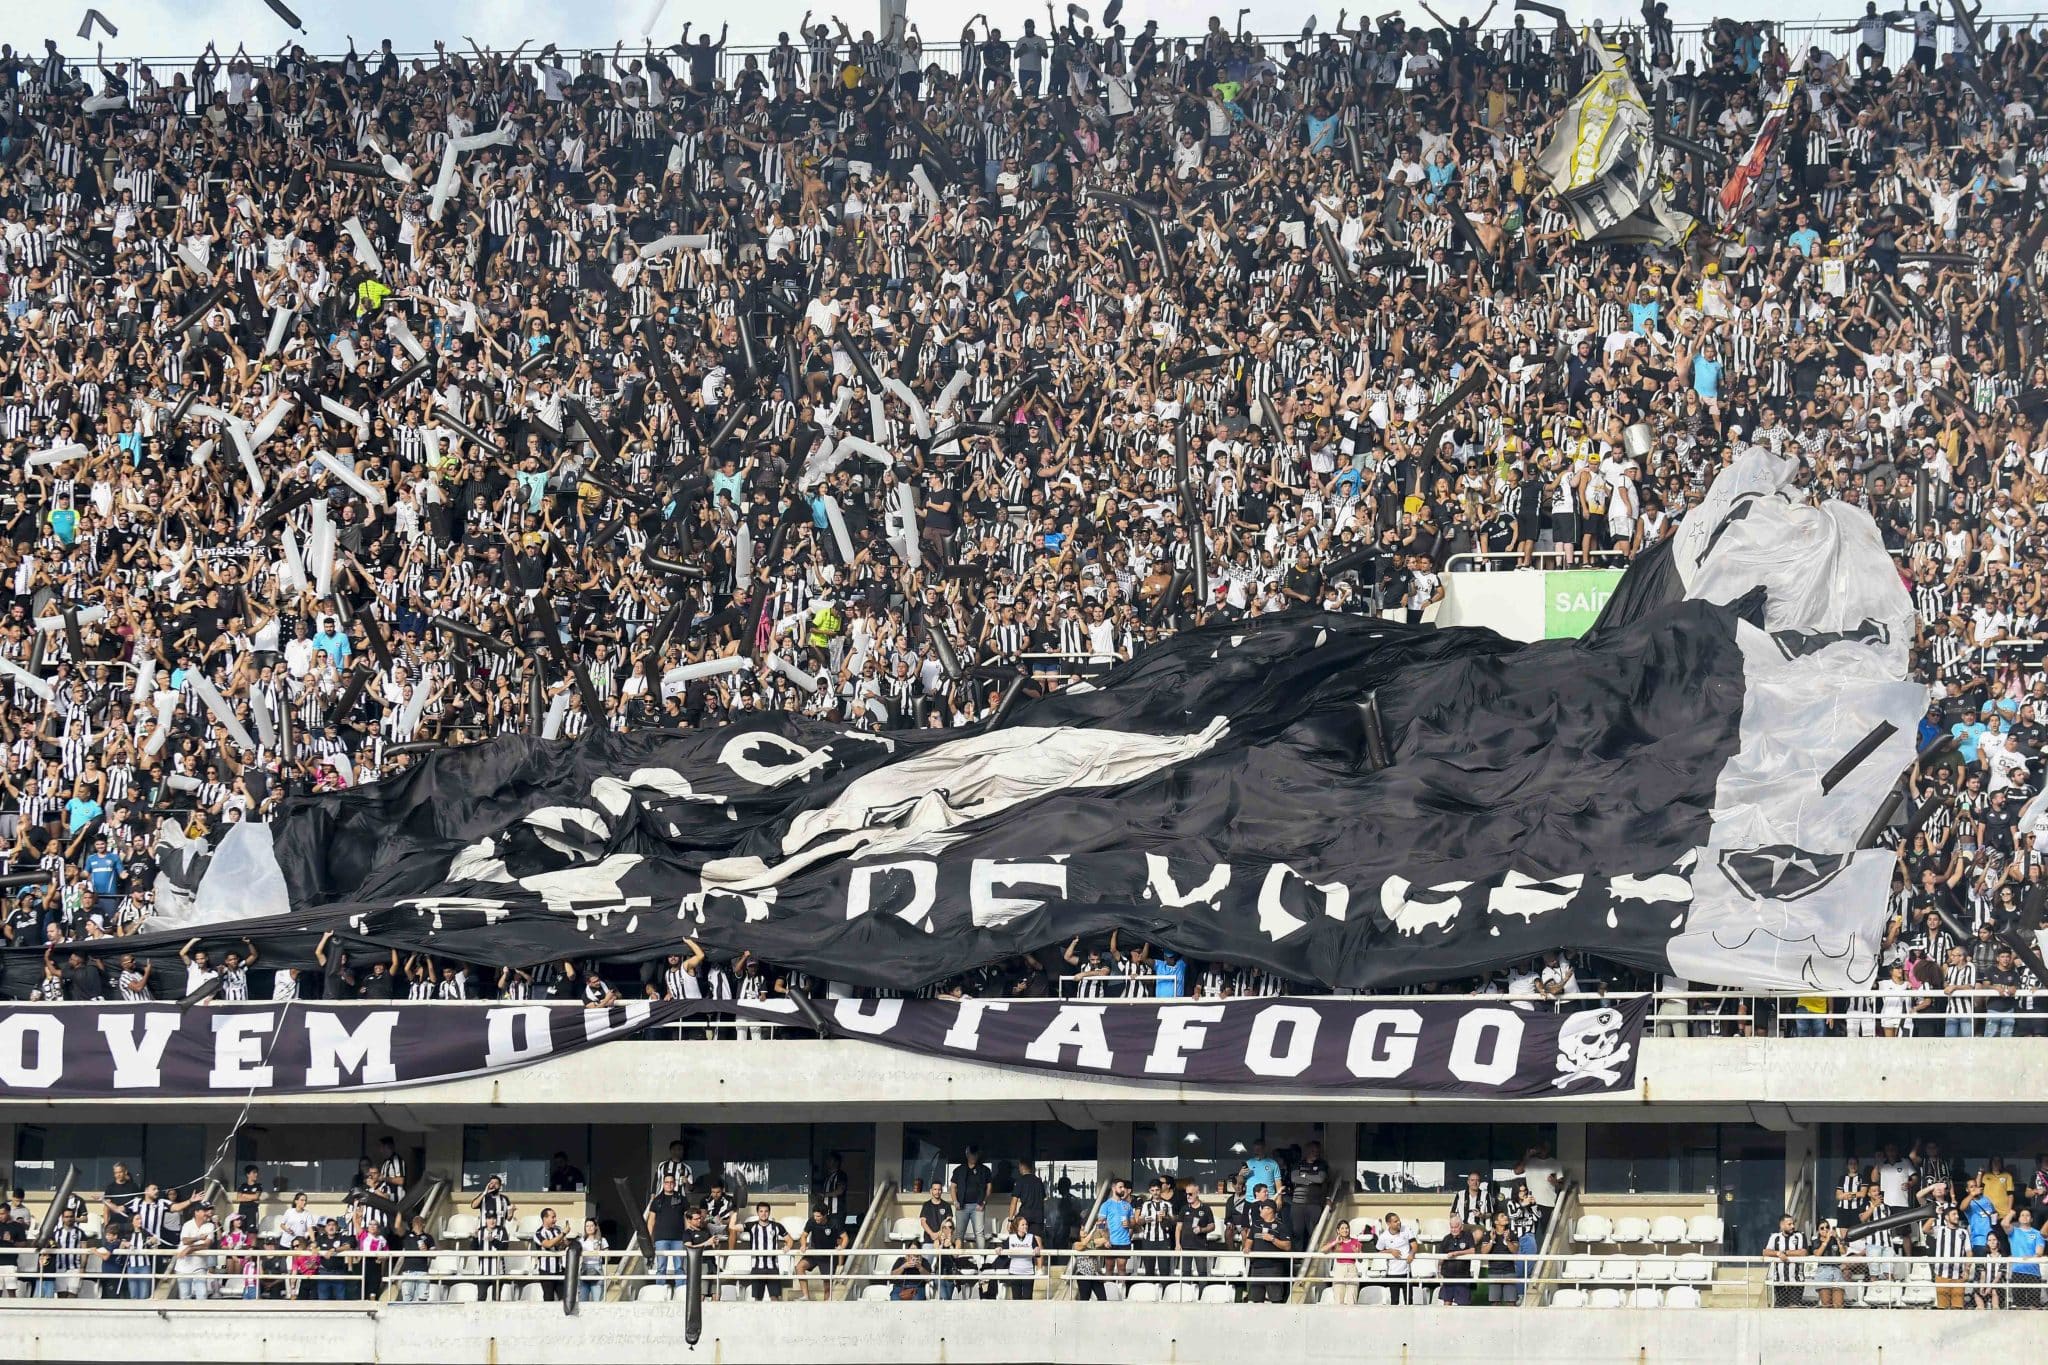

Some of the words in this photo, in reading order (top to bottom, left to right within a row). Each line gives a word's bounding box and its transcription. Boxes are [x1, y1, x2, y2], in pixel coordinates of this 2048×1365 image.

[195, 547, 252, 557] BOTAFOGO
[0, 1011, 400, 1089] OVEM
[736, 1000, 1525, 1087] TAFOGO
